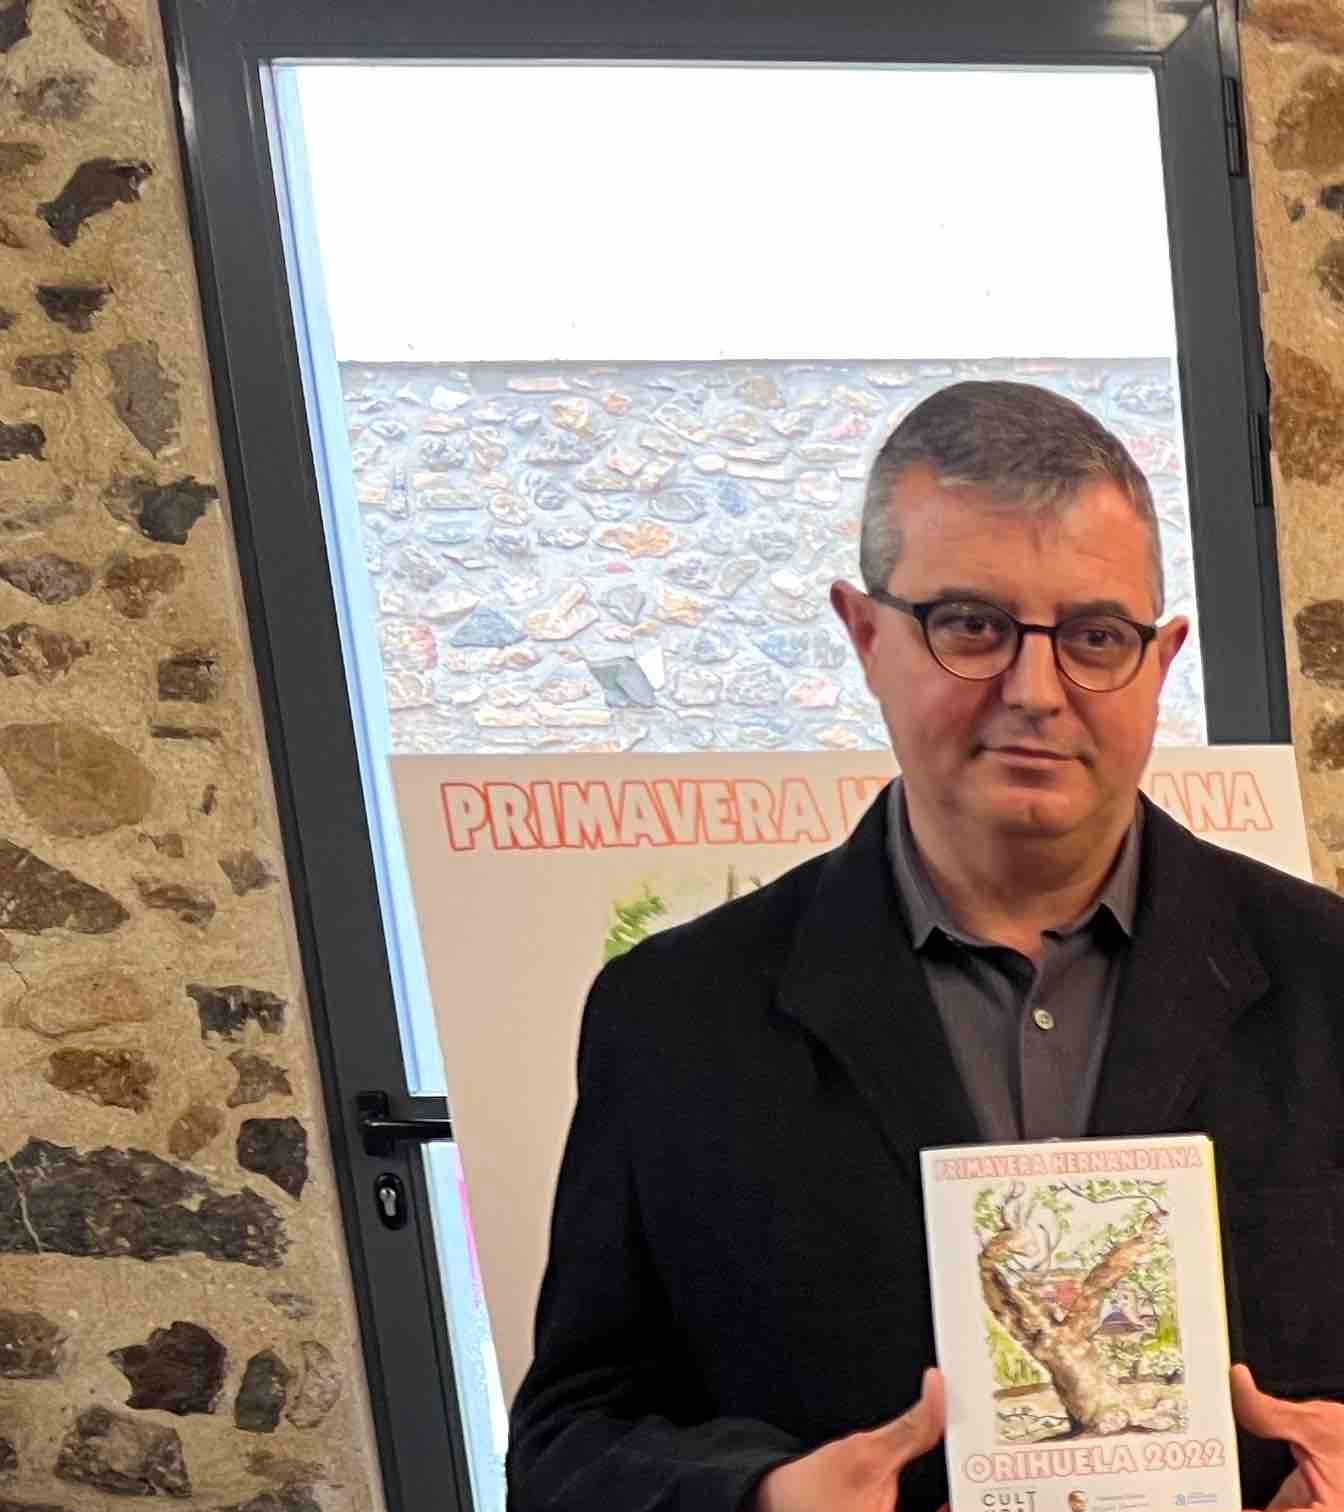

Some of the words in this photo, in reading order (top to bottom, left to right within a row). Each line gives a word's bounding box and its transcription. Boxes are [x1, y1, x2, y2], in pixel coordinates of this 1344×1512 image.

[440, 777, 832, 852] PRIMAVERA
[965, 1444, 1138, 1484] ORIHUELA
[1143, 1438, 1226, 1472] 2022
